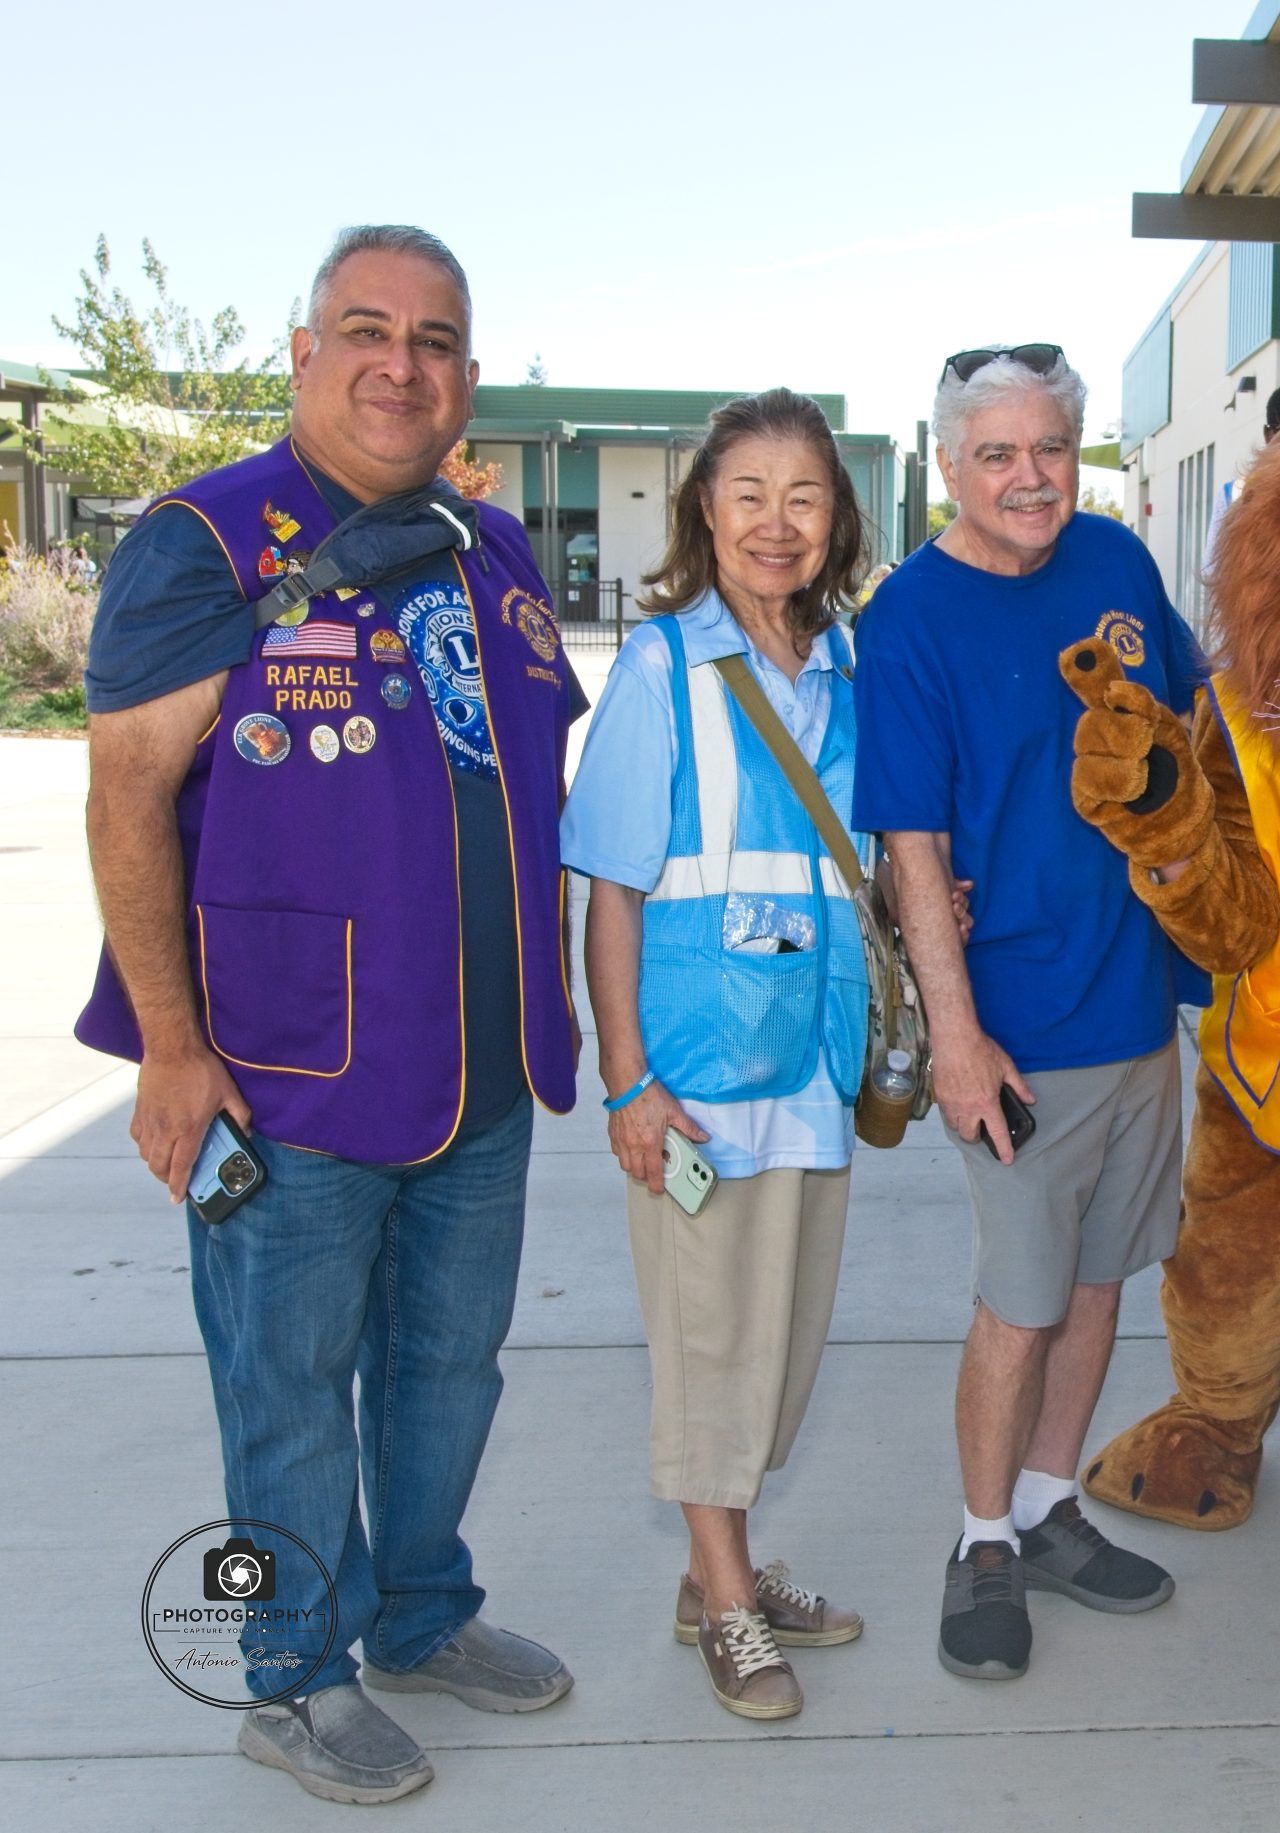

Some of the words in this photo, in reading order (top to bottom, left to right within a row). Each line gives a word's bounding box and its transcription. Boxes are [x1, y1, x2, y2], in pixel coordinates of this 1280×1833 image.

[417, 591, 450, 612] FOR
[1126, 613, 1144, 632] Lions
[449, 636, 480, 671] L
[1121, 636, 1136, 652] L
[267, 665, 358, 686] RAFAEL
[276, 690, 352, 711] PRADO
